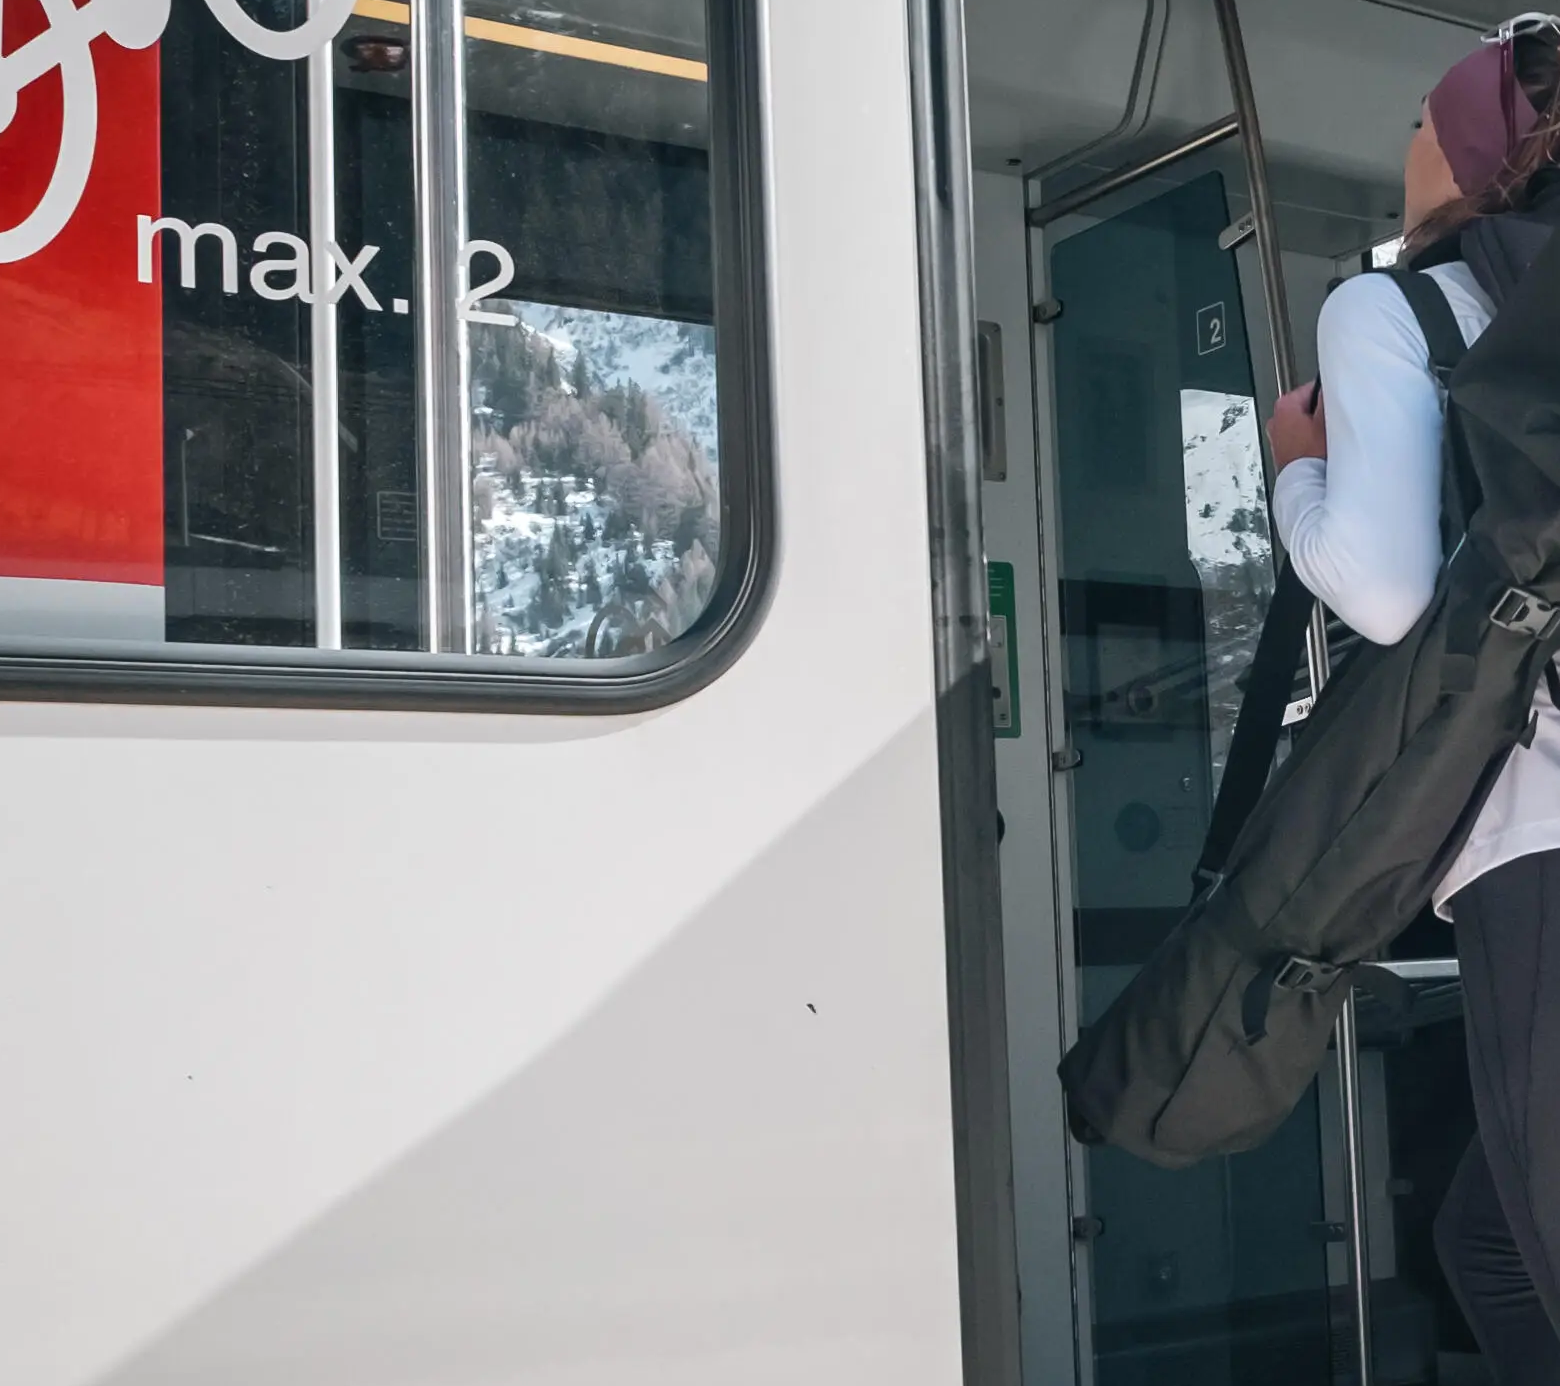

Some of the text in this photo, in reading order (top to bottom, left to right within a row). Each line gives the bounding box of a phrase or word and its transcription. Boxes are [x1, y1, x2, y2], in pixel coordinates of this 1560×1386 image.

[137, 214, 519, 327] max. 2
[1209, 317, 1222, 344] 2
